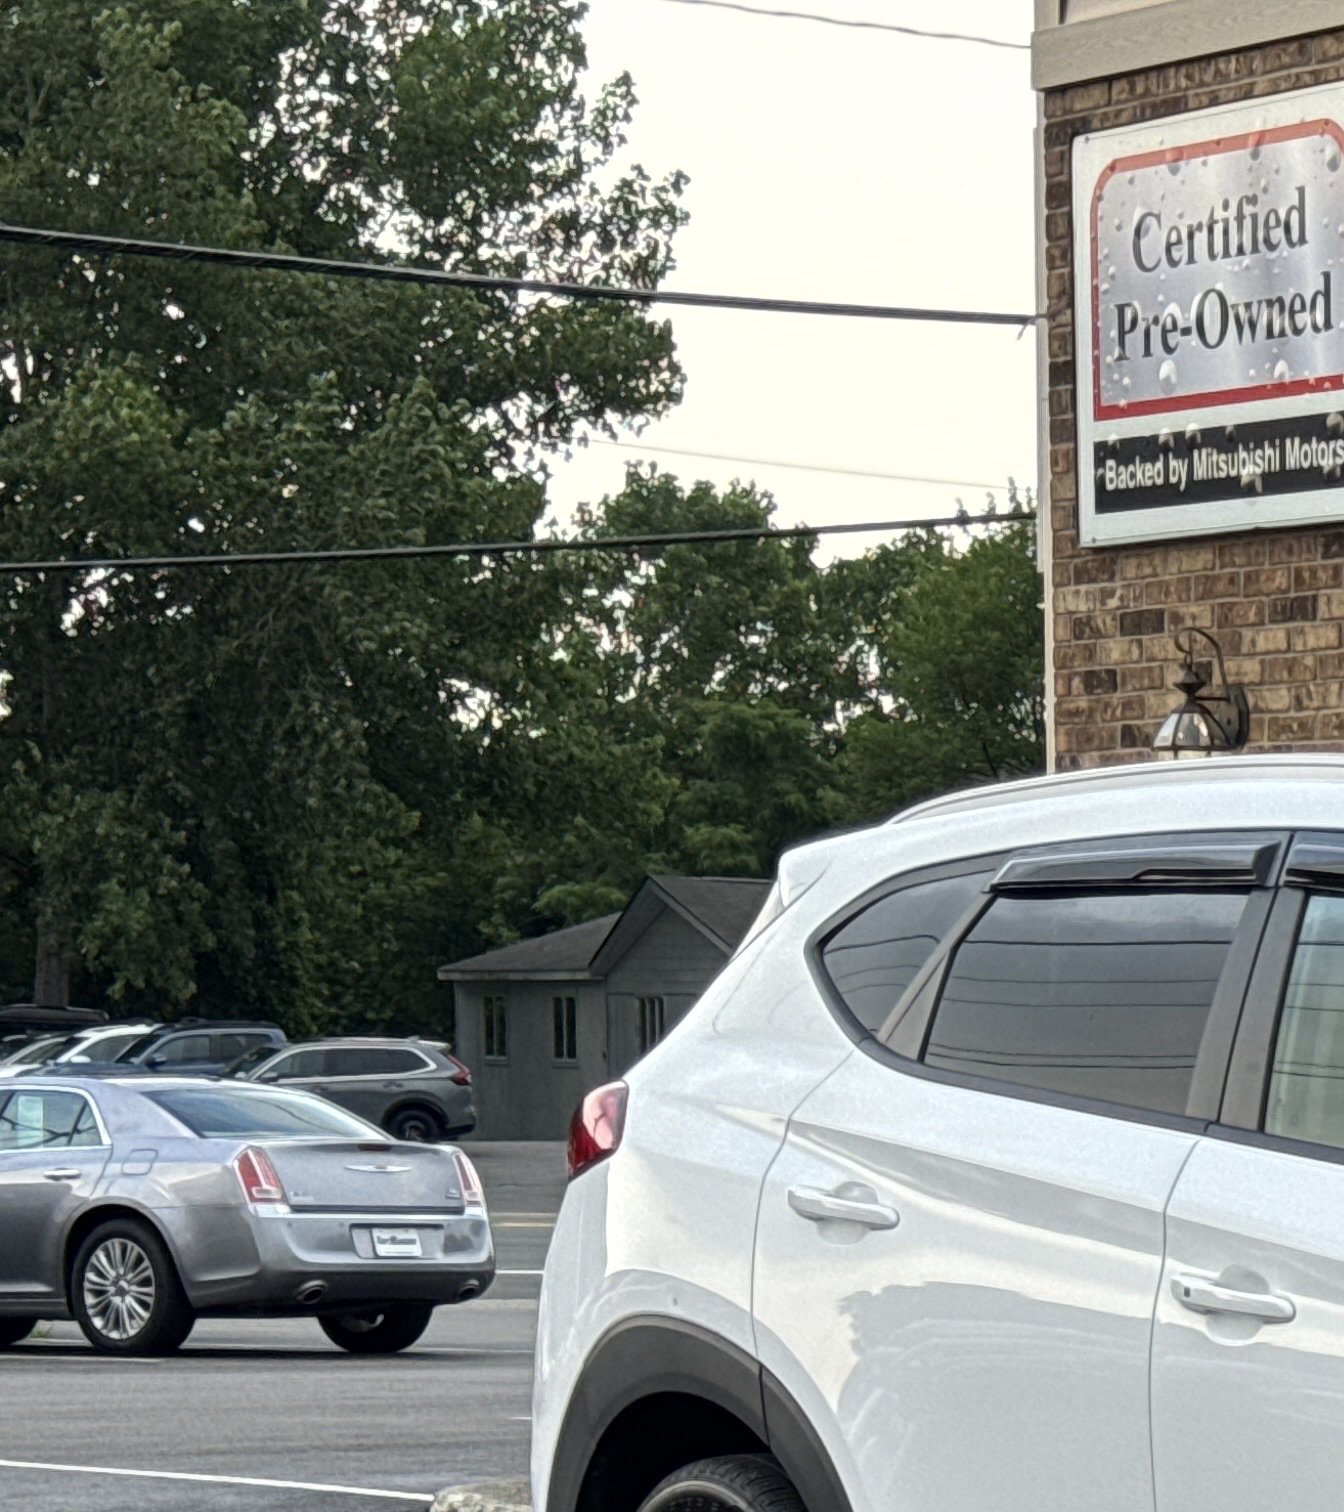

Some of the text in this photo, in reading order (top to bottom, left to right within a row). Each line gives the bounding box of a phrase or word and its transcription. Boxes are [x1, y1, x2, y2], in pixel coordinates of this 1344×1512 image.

[1132, 186, 1308, 273] Certified
[1114, 271, 1334, 362] Pre-Owned
[1104, 454, 1164, 492] Backed
[1168, 453, 1189, 493] by
[1193, 441, 1281, 484] Mitsubishi
